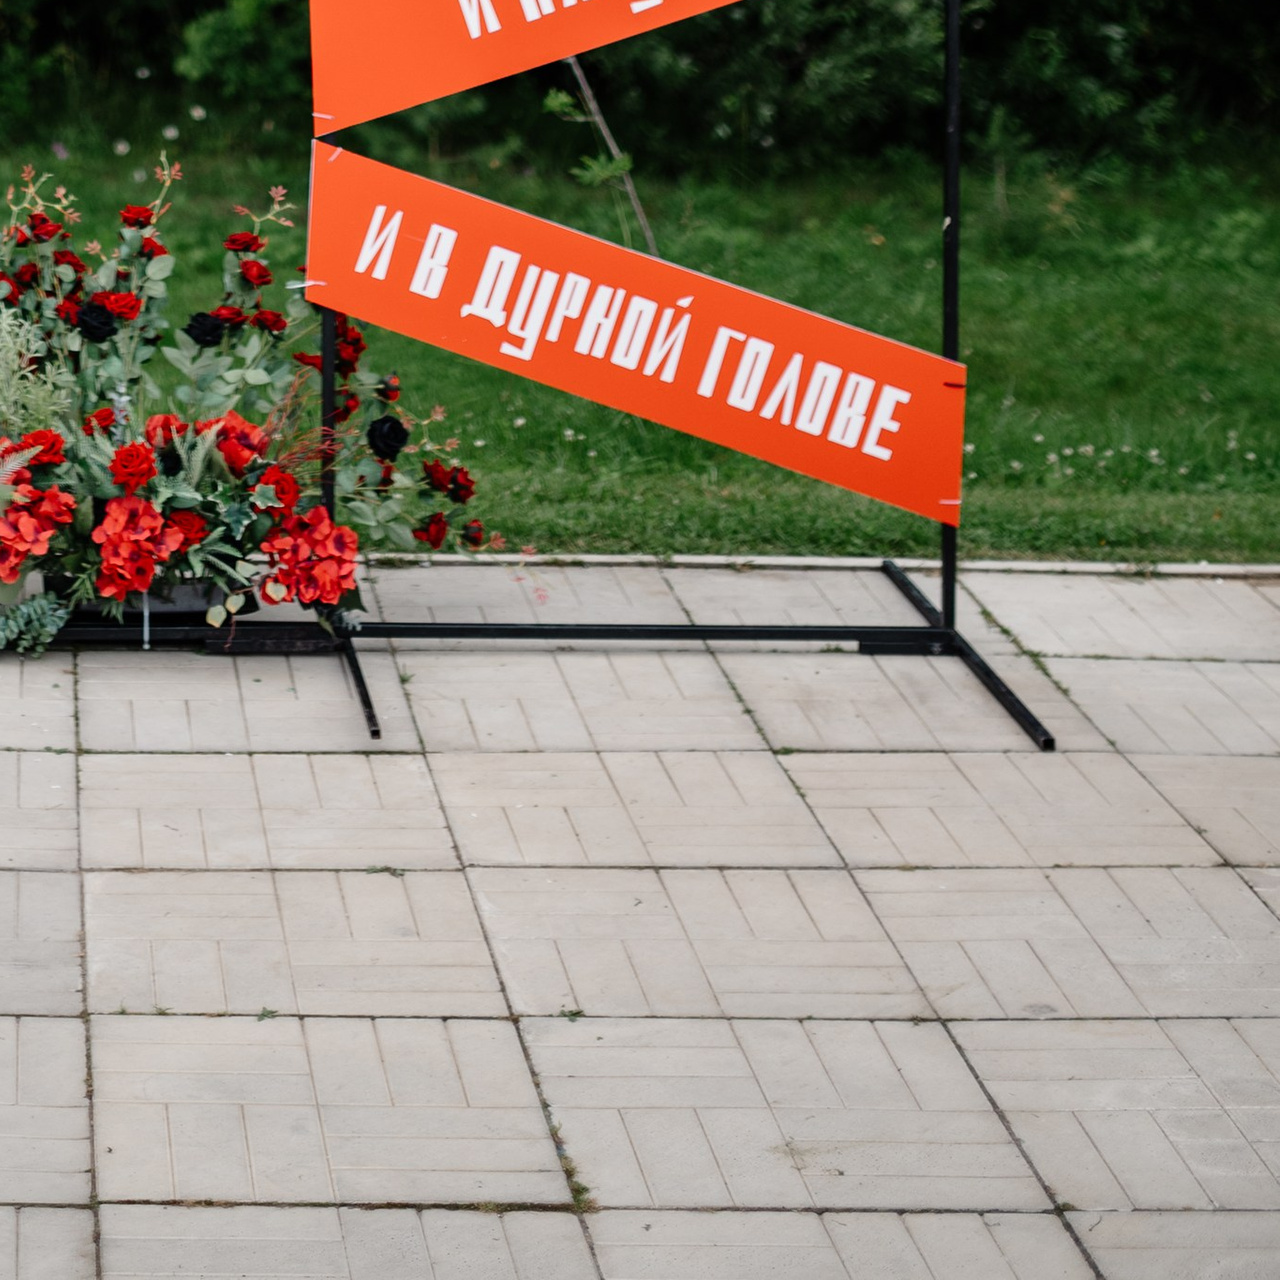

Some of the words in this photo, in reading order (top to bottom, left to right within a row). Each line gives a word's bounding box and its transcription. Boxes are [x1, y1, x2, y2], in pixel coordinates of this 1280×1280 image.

[354, 204, 404, 281] И
[409, 223, 458, 300] В
[460, 245, 695, 383] ДУРНОЙ
[697, 326, 912, 461] ГОЛОВЕ
